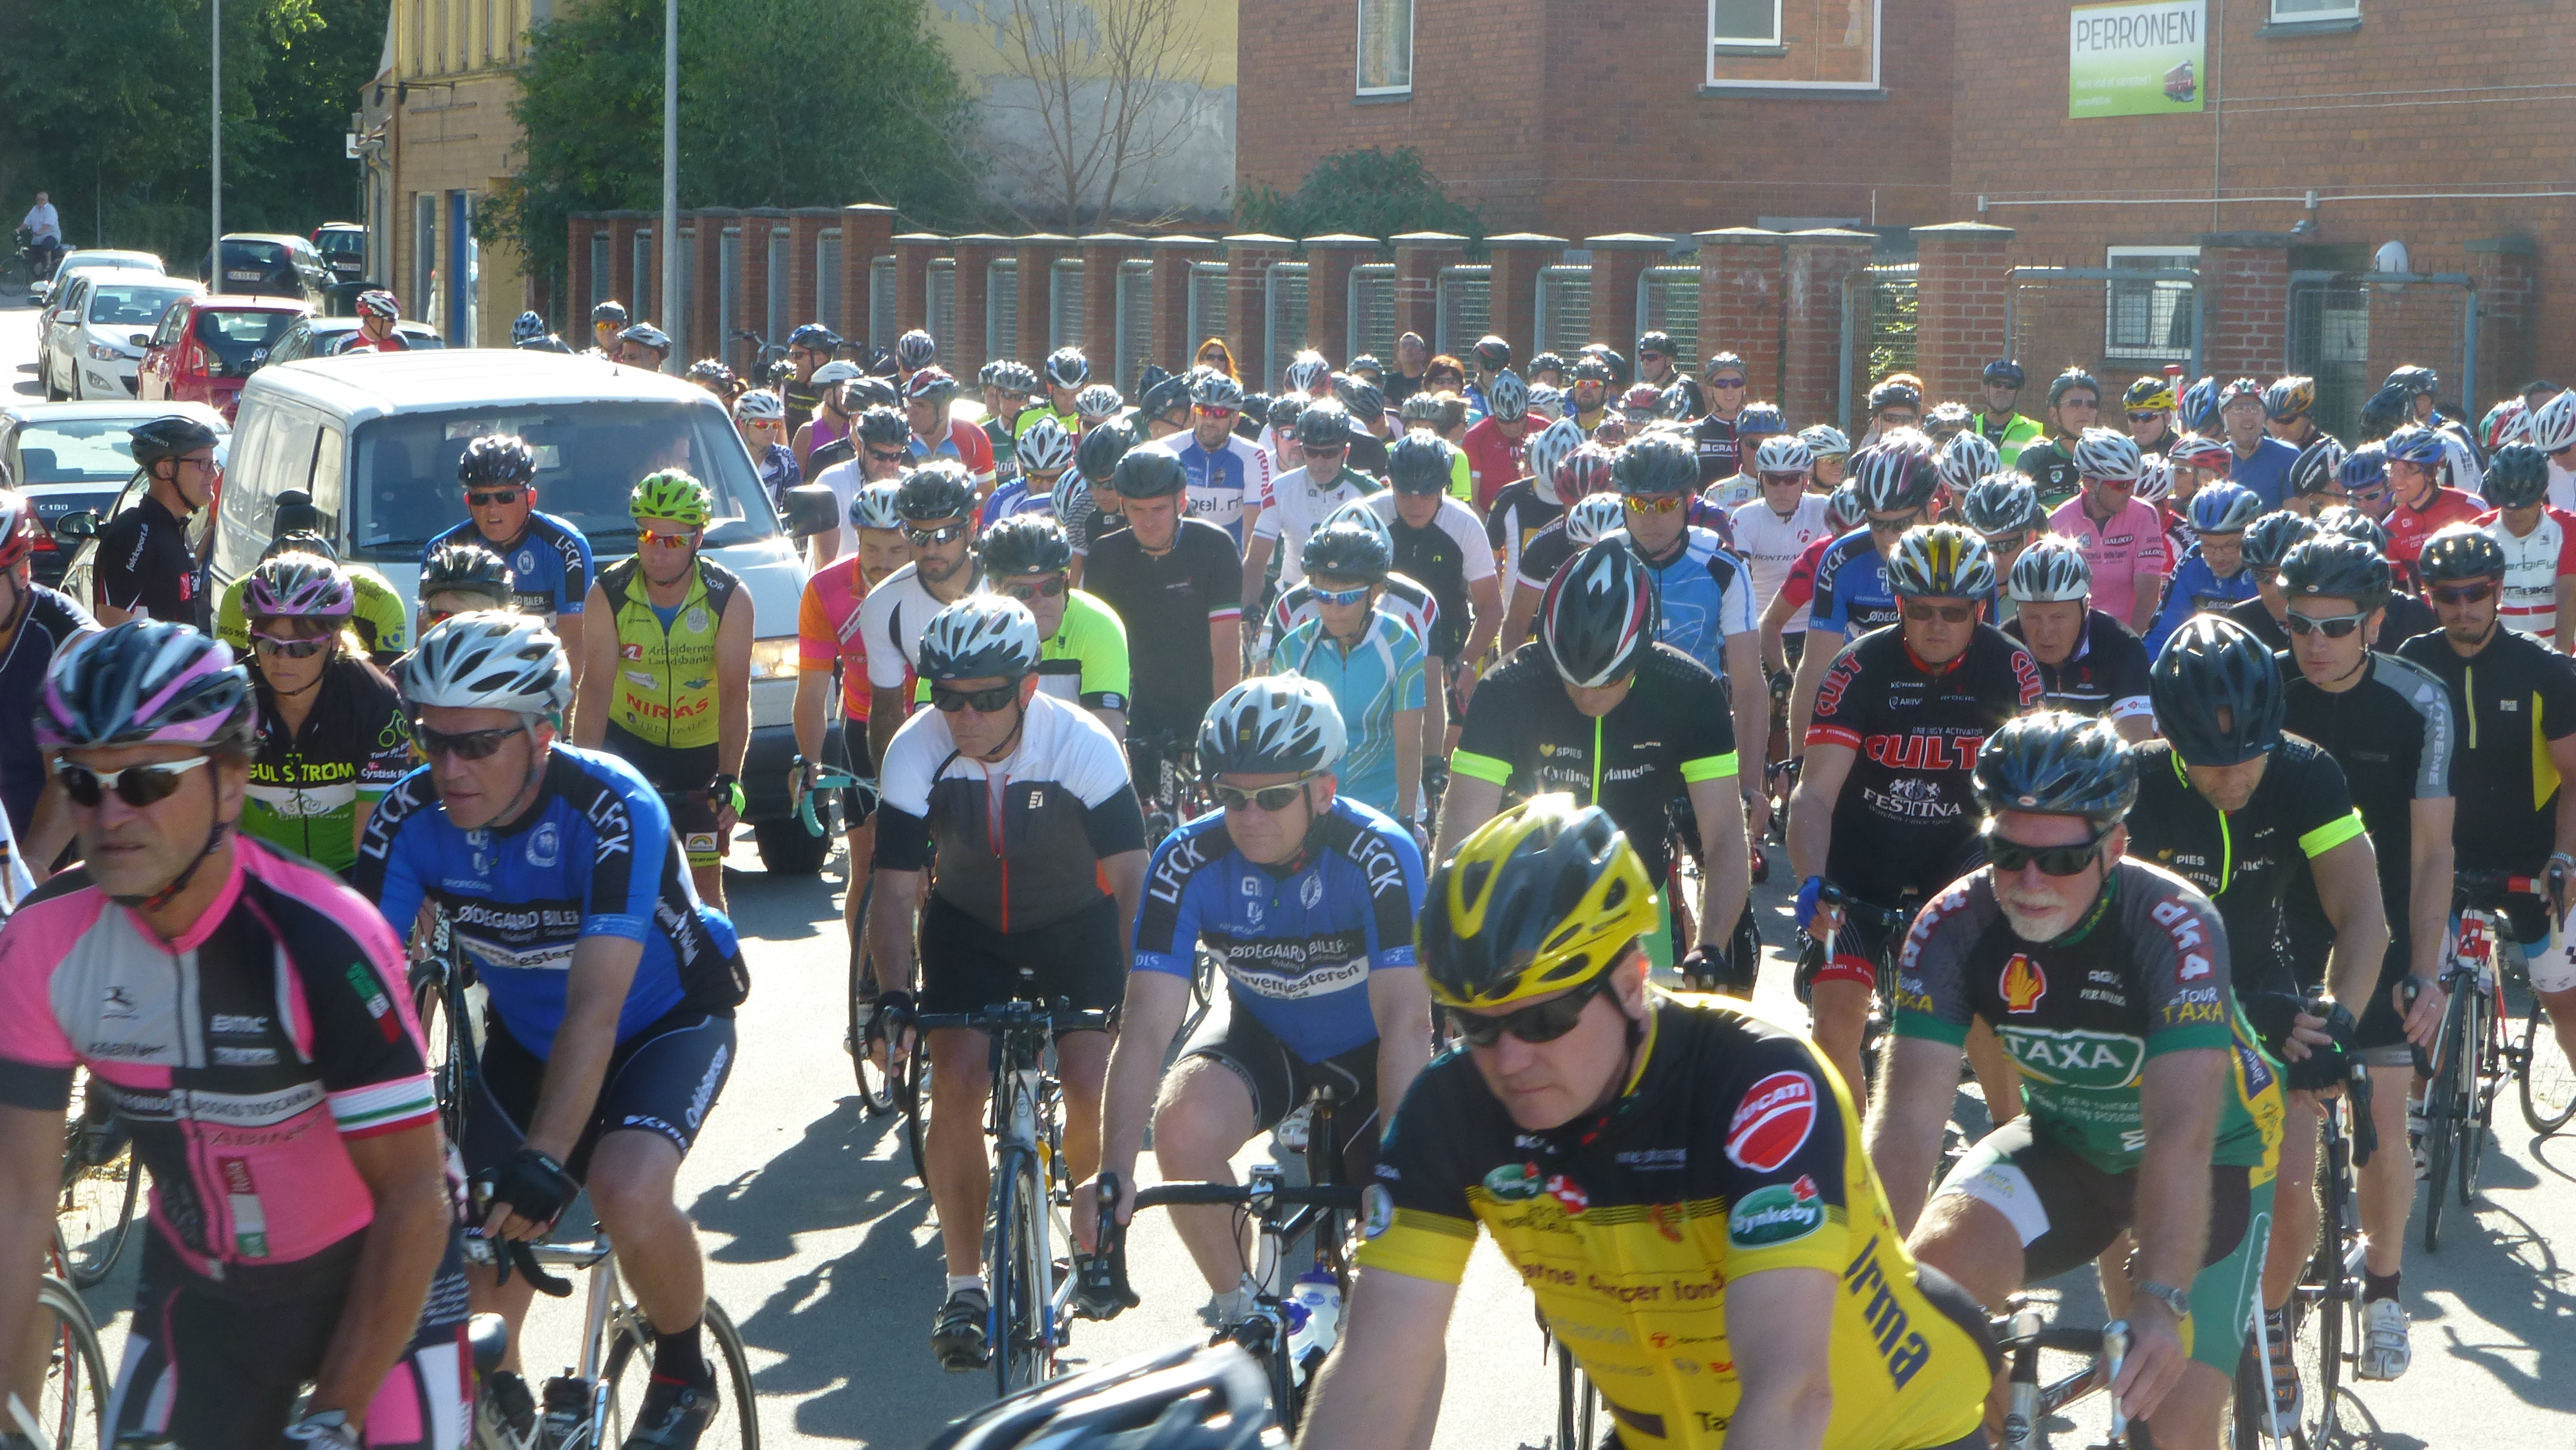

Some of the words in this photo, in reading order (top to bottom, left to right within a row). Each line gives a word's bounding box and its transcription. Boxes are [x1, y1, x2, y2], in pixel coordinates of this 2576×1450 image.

[2076, 10, 2196, 52] PERRONEN
[1711, 444, 1738, 453] CRAT
[553, 535, 583, 572] LFCK
[1818, 547, 1847, 592] LFCK
[1815, 650, 1862, 717] CULT
[1865, 733, 1985, 770] CULT
[1863, 786, 1962, 817] FESTINA
[360, 781, 421, 860] LFCK
[588, 788, 631, 865] LFCK
[1148, 837, 1207, 905] LFCK
[1347, 829, 1403, 900] LFCK
[2174, 854, 2205, 866] PIES
[452, 903, 540, 931] ØDEGAARD
[1229, 943, 1306, 963] ØDEGAARD
[1309, 938, 1346, 955] BILER
[2162, 1000, 2225, 1024] TAXA
[2179, 986, 2218, 1003] TOUR
[2006, 1034, 2125, 1070] TAXA
[1845, 1234, 1931, 1392] Irma
